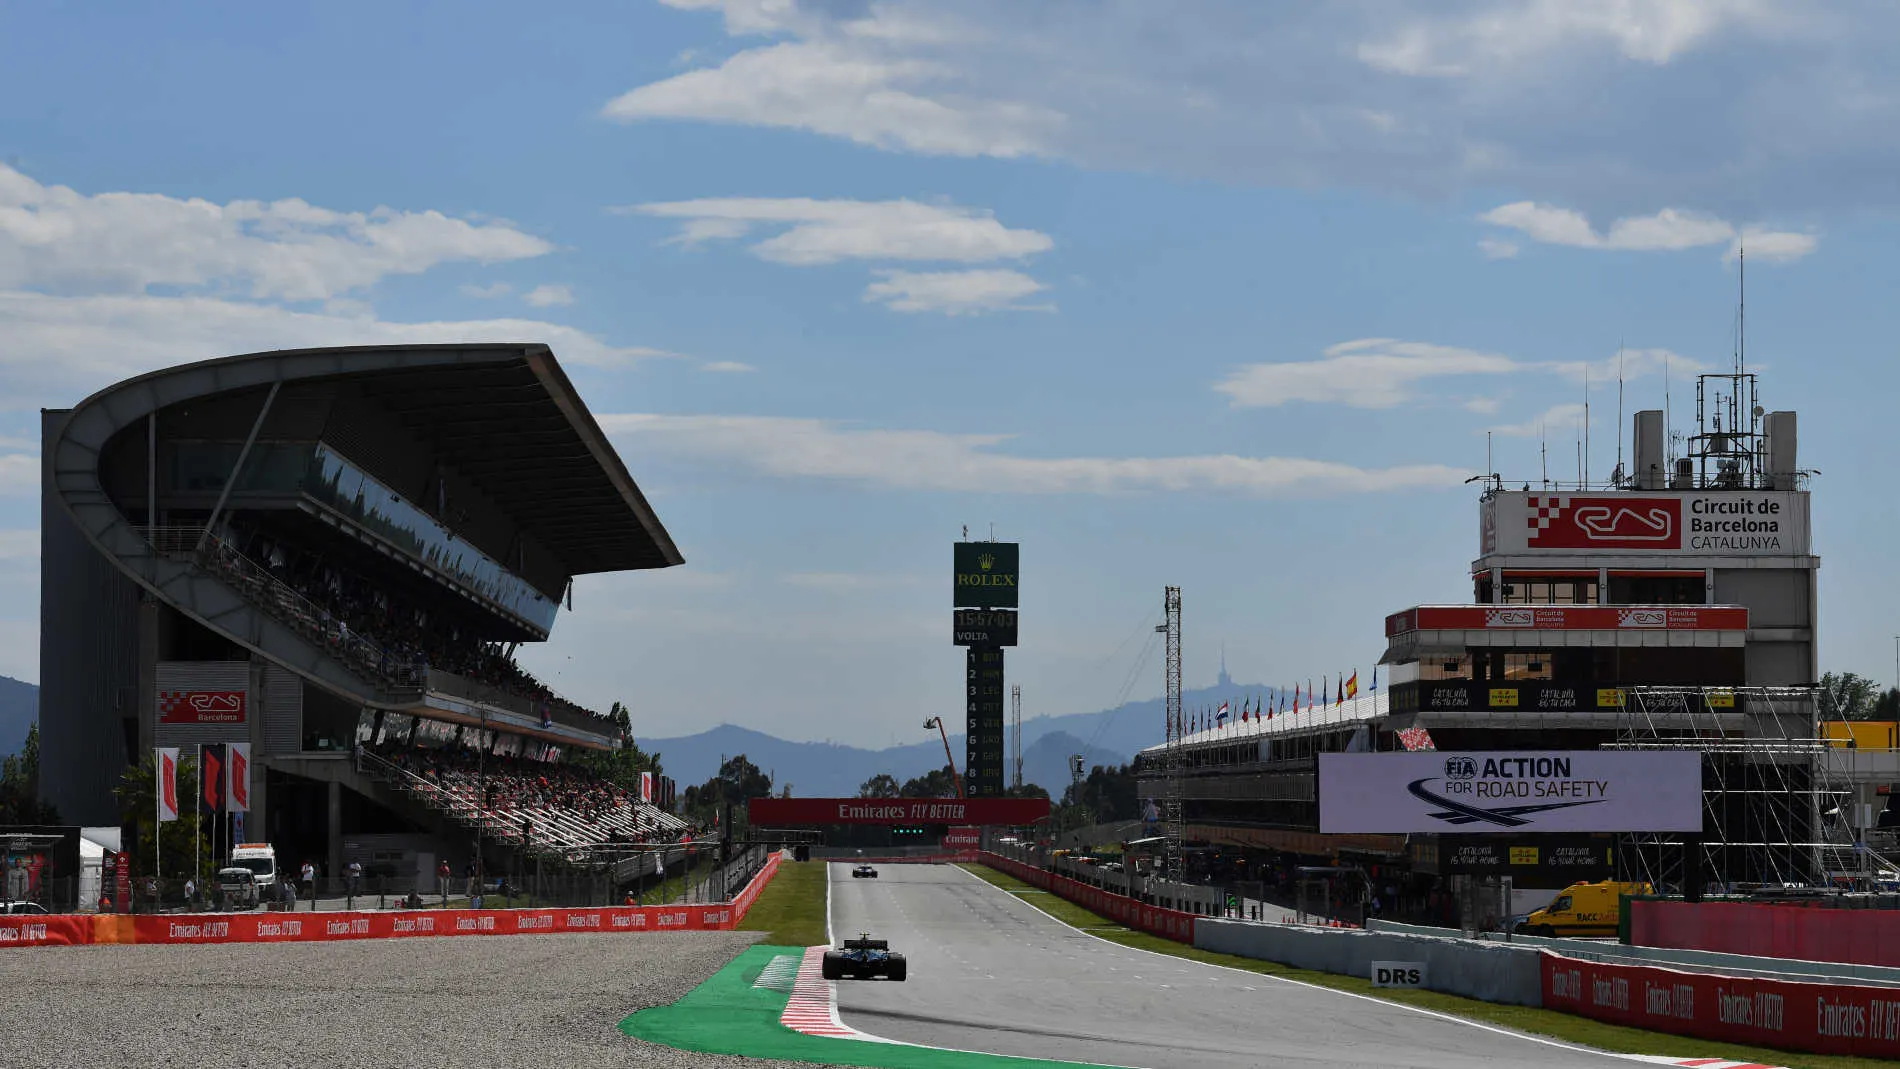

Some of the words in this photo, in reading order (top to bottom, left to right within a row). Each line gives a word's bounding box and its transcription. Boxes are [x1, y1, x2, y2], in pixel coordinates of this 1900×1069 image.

[1691, 498, 1753, 514] Circuit
[1759, 498, 1780, 514] de
[1691, 517, 1779, 533] Barcelona
[1691, 536, 1780, 549] CATALUNYA
[957, 573, 1016, 587] ROLEX
[957, 631, 988, 642] VOLTA
[970, 653, 977, 663] 1
[969, 669, 977, 679] 2
[969, 686, 977, 696] 3
[969, 702, 977, 712] 4
[197, 712, 238, 721] Barcelona
[970, 719, 977, 729] 5
[970, 735, 977, 745] 6
[969, 751, 977, 762] 7
[970, 768, 977, 778] 8
[1446, 761, 1475, 775] FIA
[1482, 757, 1570, 778] ACTION
[970, 785, 977, 795] 9
[1446, 782, 1473, 794] FOR
[1477, 781, 1529, 798] ROAD
[1535, 781, 1608, 798] SAFETY
[839, 803, 906, 819] Emirates
[910, 803, 929, 819] FLY
[930, 803, 966, 819] BETTER
[169, 921, 201, 938] Emirates
[1377, 968, 1420, 985] DRS
[1646, 980, 1672, 1017] Emirates
[1717, 987, 1753, 1026] Emirates
[1765, 993, 1784, 1032] BETTER
[1817, 996, 1866, 1038] Emirates
[1869, 999, 1884, 1039] FLY
